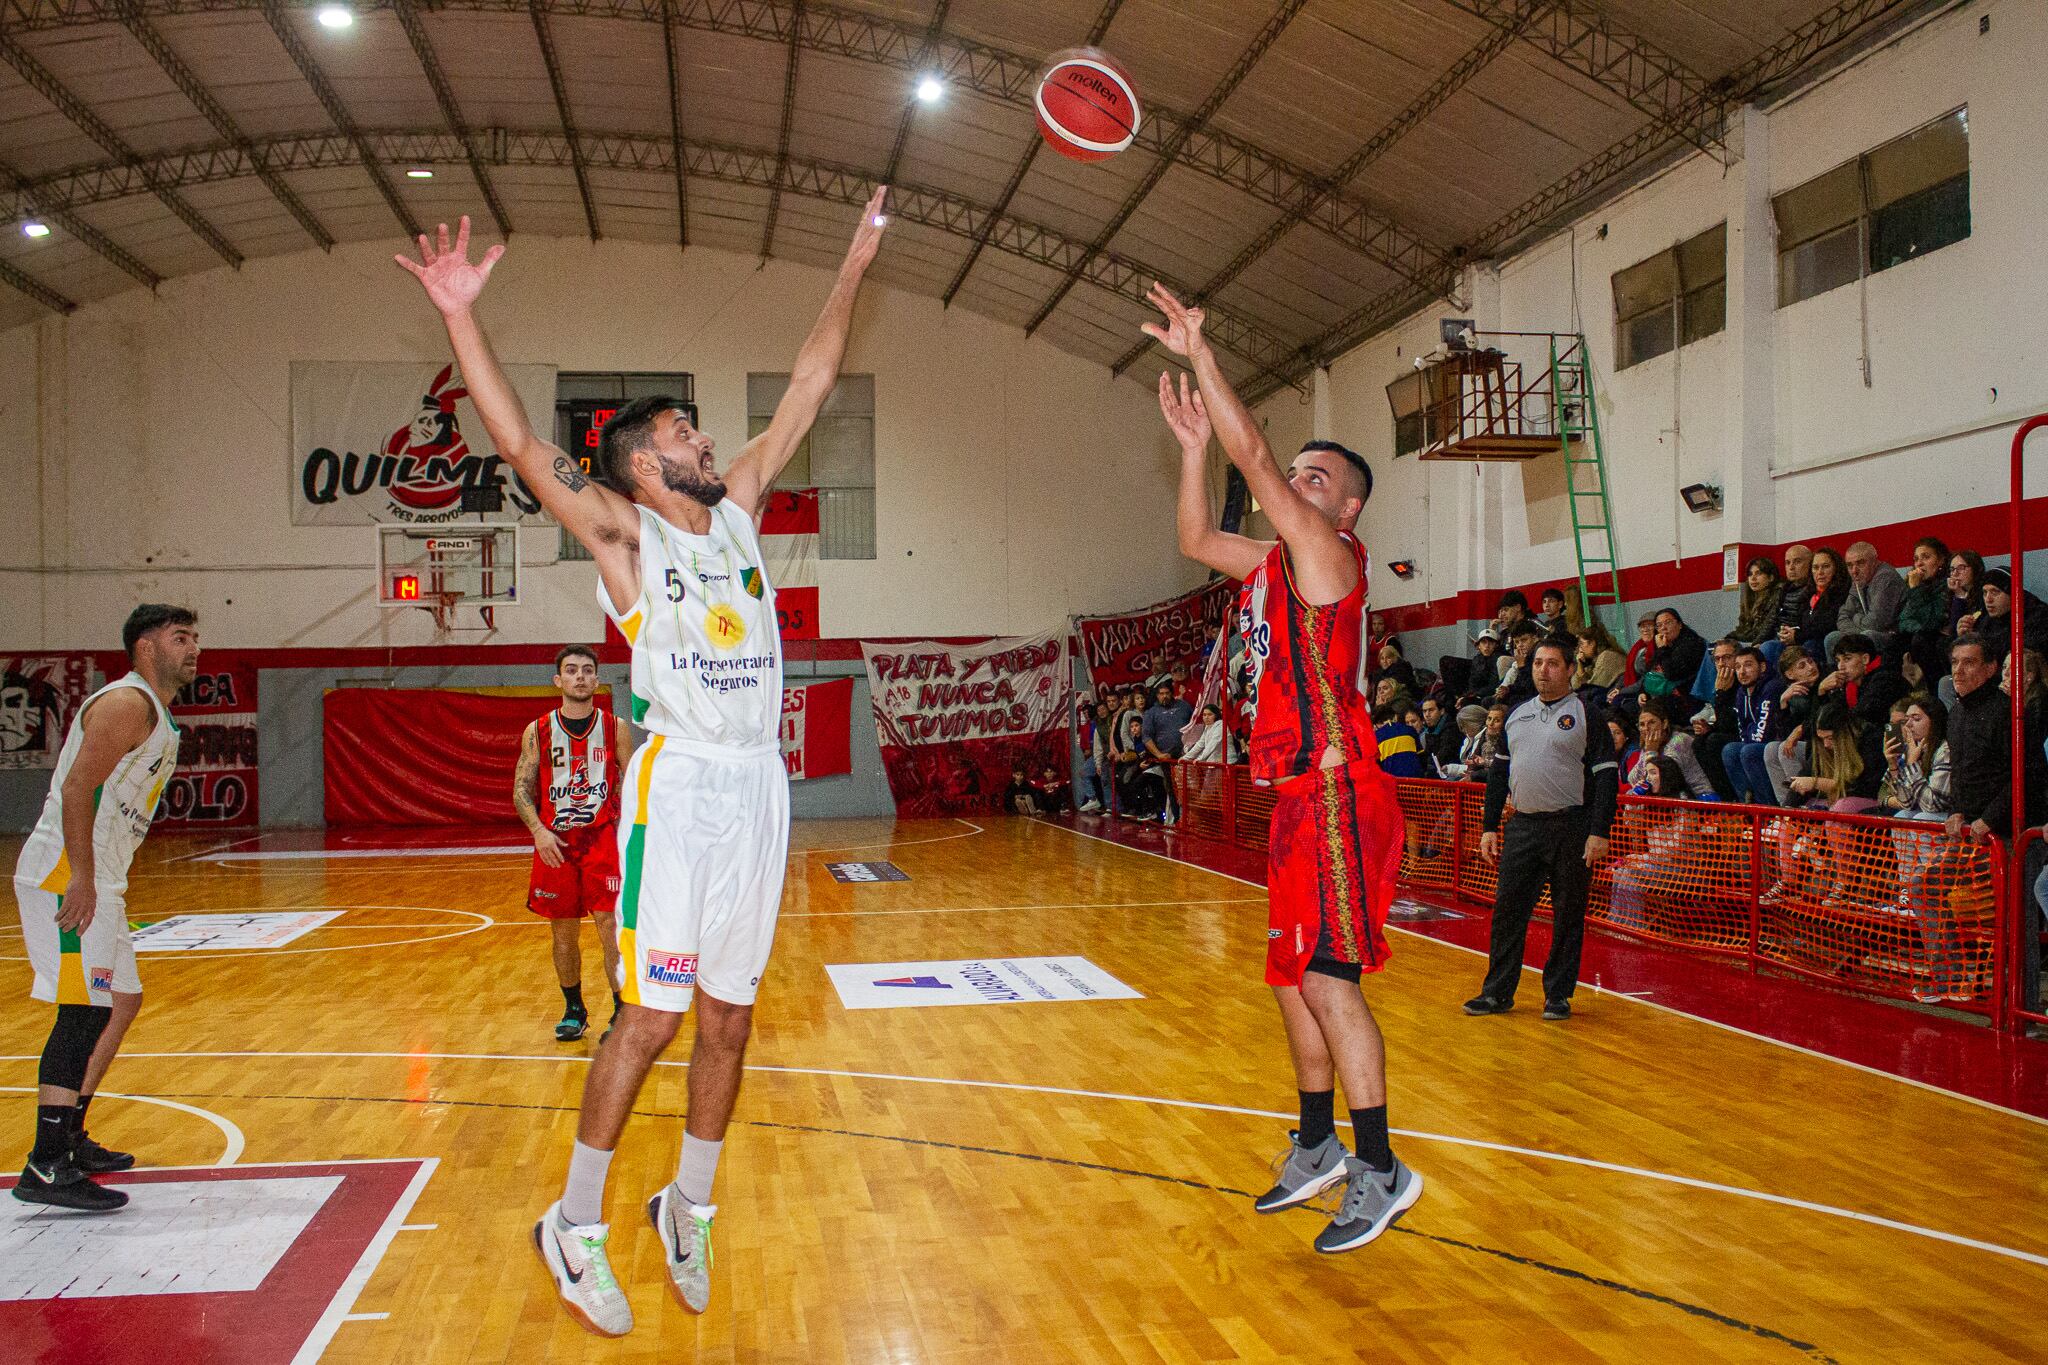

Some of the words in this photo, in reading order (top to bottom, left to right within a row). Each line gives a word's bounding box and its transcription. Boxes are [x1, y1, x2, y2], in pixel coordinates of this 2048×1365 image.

[1068, 72, 1117, 105] molten
[386, 502, 413, 522] TRES
[414, 506, 465, 523] ARROYOS
[664, 568, 686, 603] 5
[1090, 621, 1145, 668] NADA
[1146, 609, 1184, 637] MAS
[671, 653, 688, 670] La
[873, 653, 955, 683] PLATA
[960, 656, 987, 682] Y
[701, 672, 758, 695] Seguros
[918, 679, 1017, 710] NUNCA
[148, 757, 163, 776] 4
[550, 782, 608, 801] QUILMES
